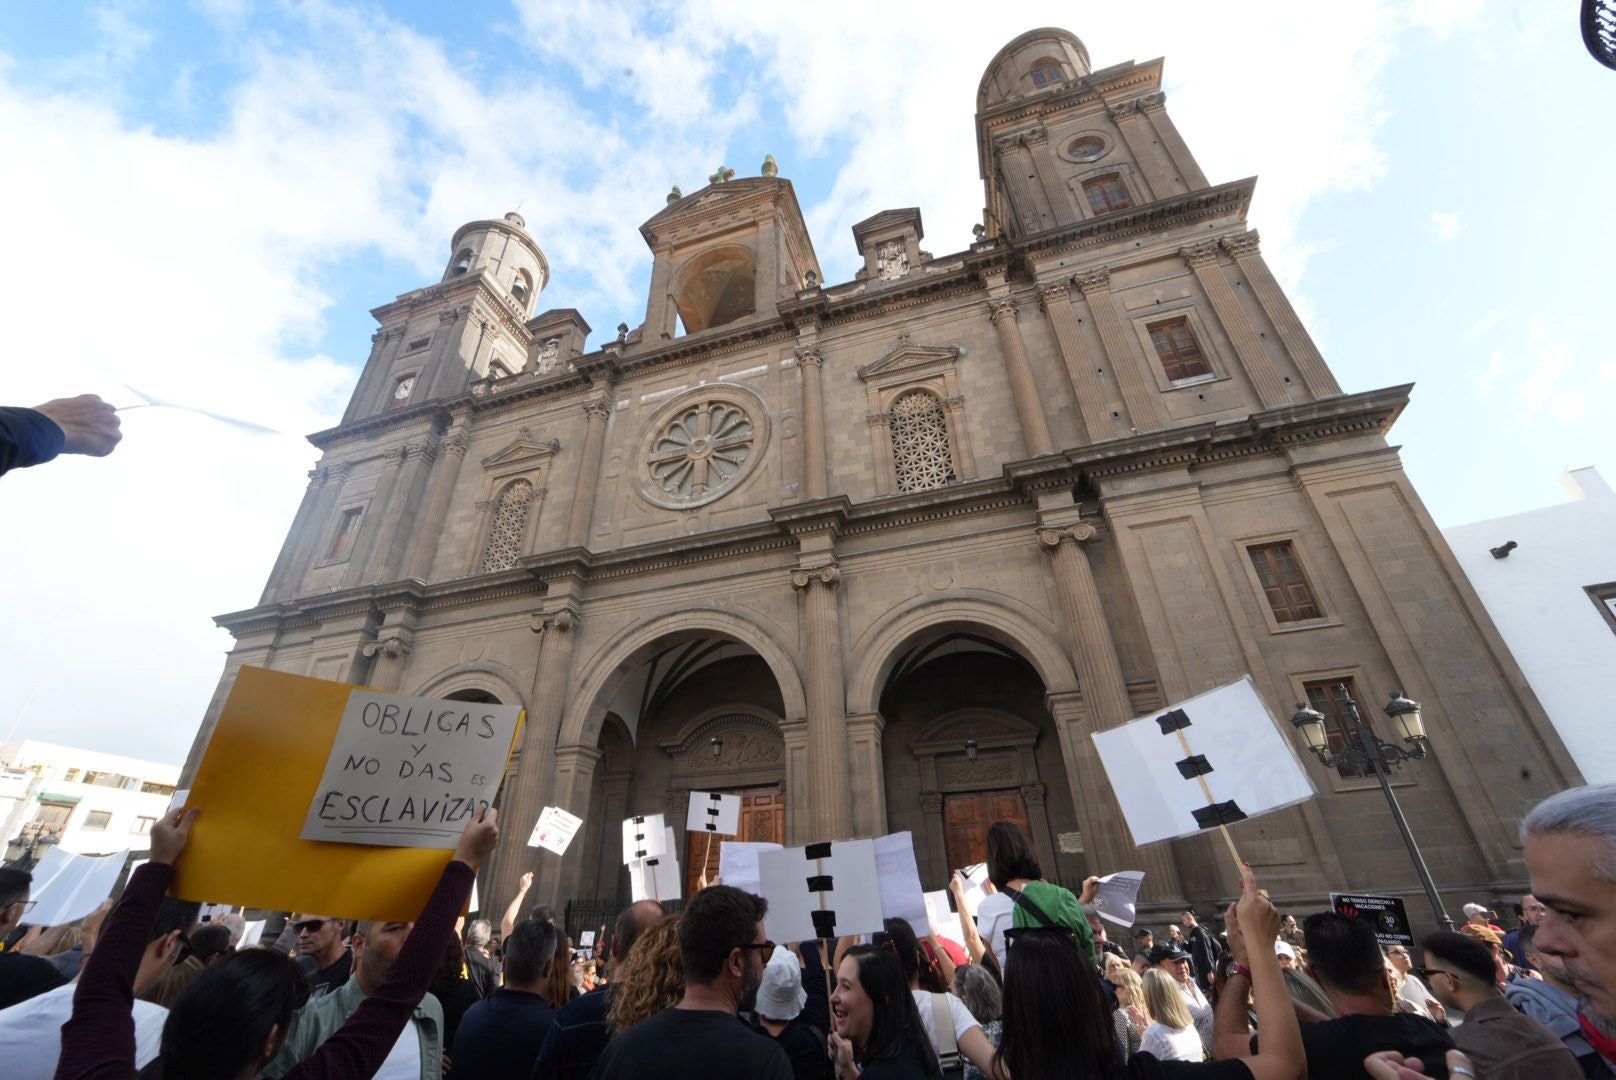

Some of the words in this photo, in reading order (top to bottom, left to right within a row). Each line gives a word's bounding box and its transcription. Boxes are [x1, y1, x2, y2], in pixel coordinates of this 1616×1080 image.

[362, 702, 495, 739] OBLIGAS
[411, 743, 427, 758] Y
[344, 754, 380, 775] NO
[399, 760, 453, 783] DAS
[470, 774, 485, 786] ES
[1384, 916, 1395, 924] 30
